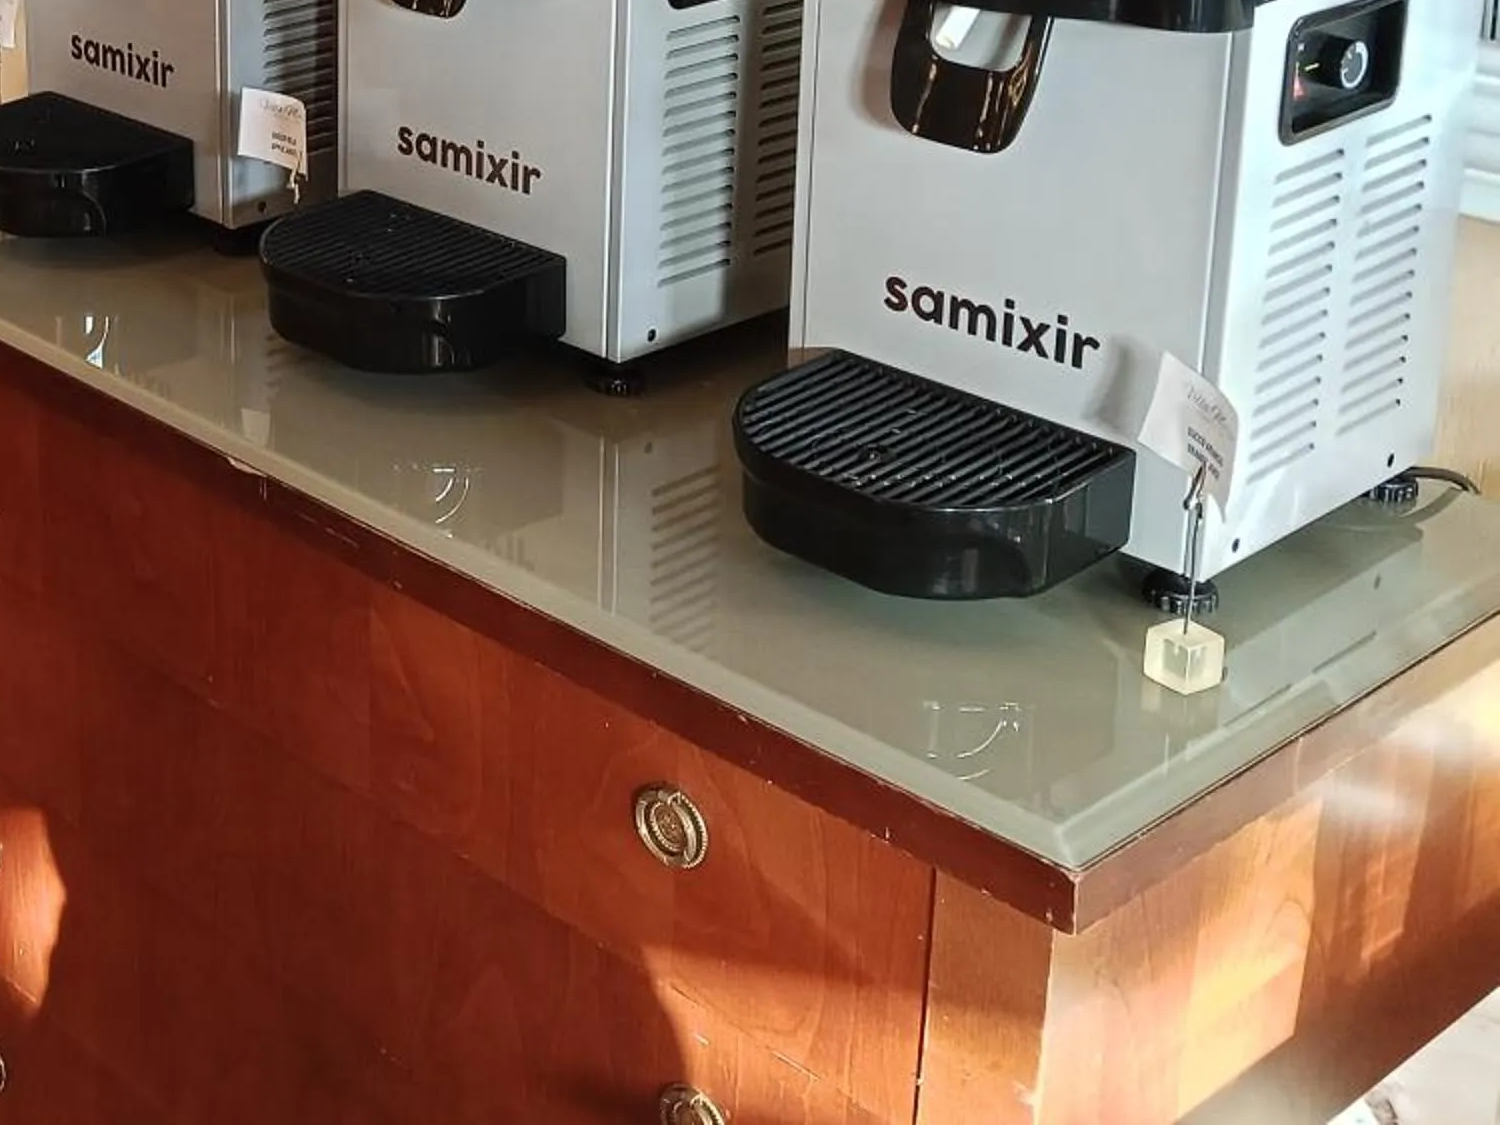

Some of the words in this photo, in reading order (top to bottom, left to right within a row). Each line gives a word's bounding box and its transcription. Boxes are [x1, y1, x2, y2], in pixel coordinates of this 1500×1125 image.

[70, 33, 175, 88] samixir
[396, 125, 542, 196] samixir
[883, 275, 1101, 369] samixir
